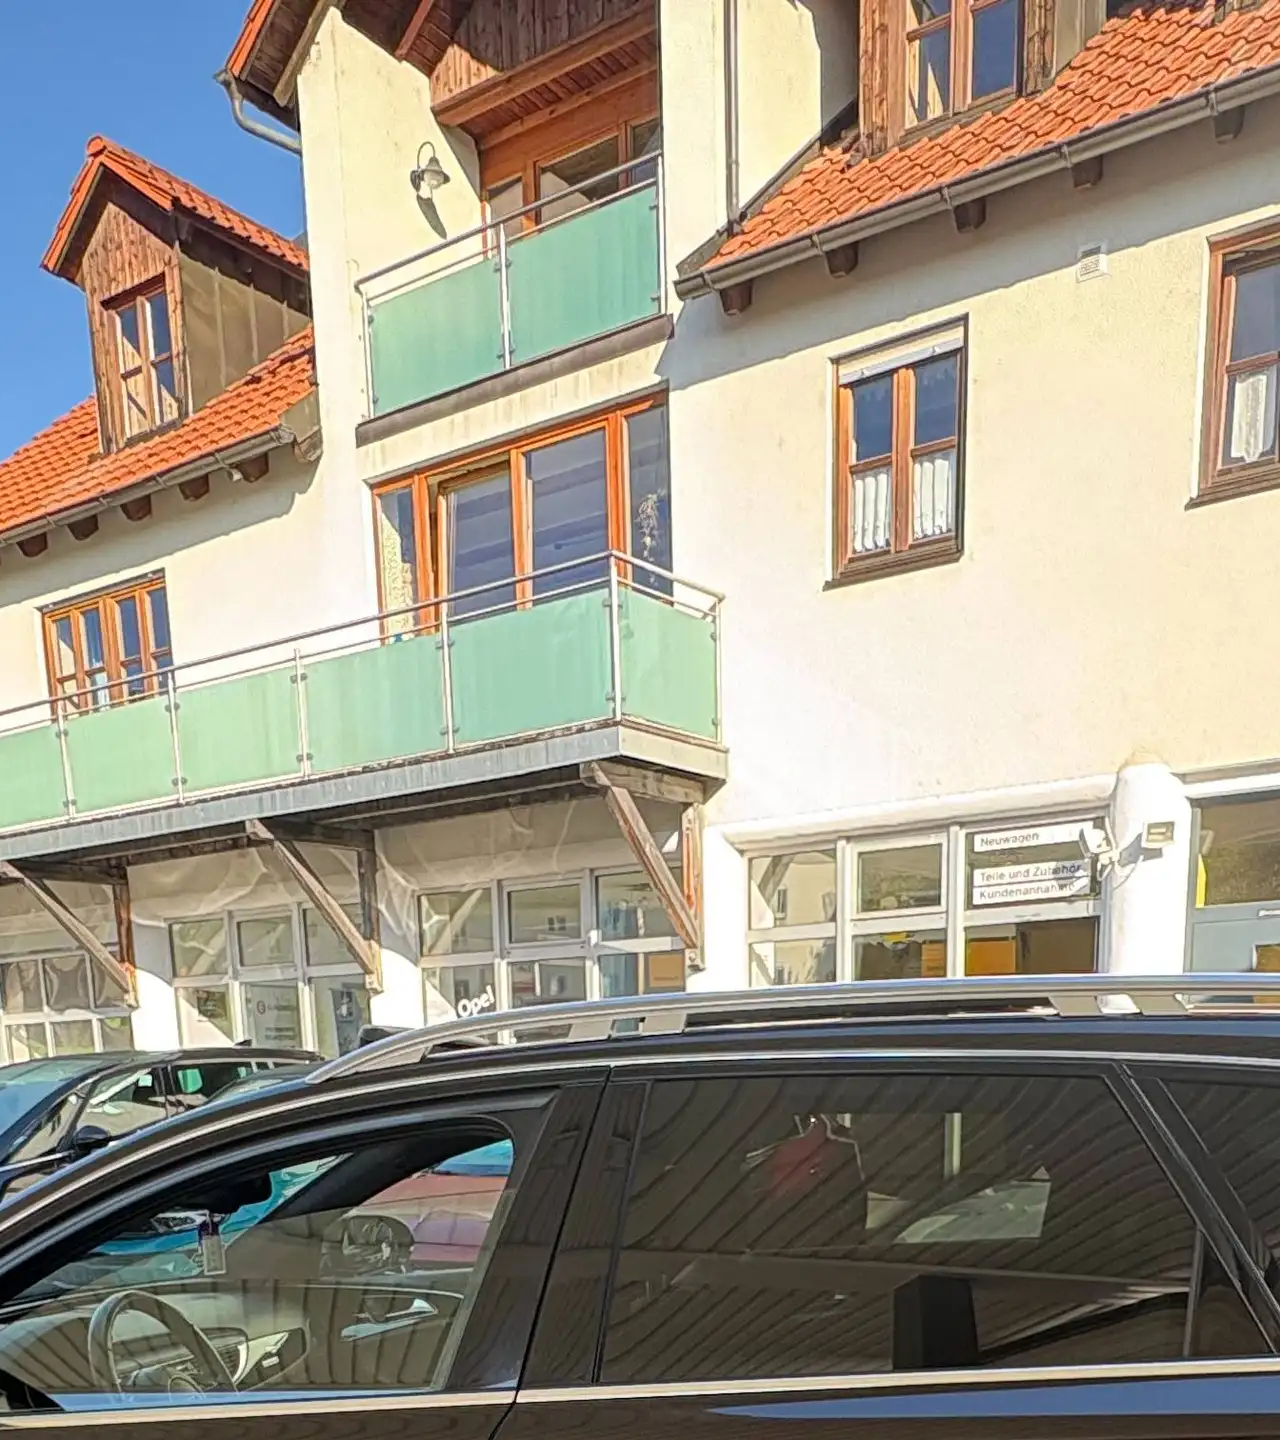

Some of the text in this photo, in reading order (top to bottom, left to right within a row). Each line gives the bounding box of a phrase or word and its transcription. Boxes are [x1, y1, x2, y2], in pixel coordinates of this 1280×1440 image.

[980, 831, 1040, 848] Neuwagen
[980, 870, 1006, 883] Teile
[1008, 867, 1030, 880] und
[457, 984, 496, 1018] Opel
